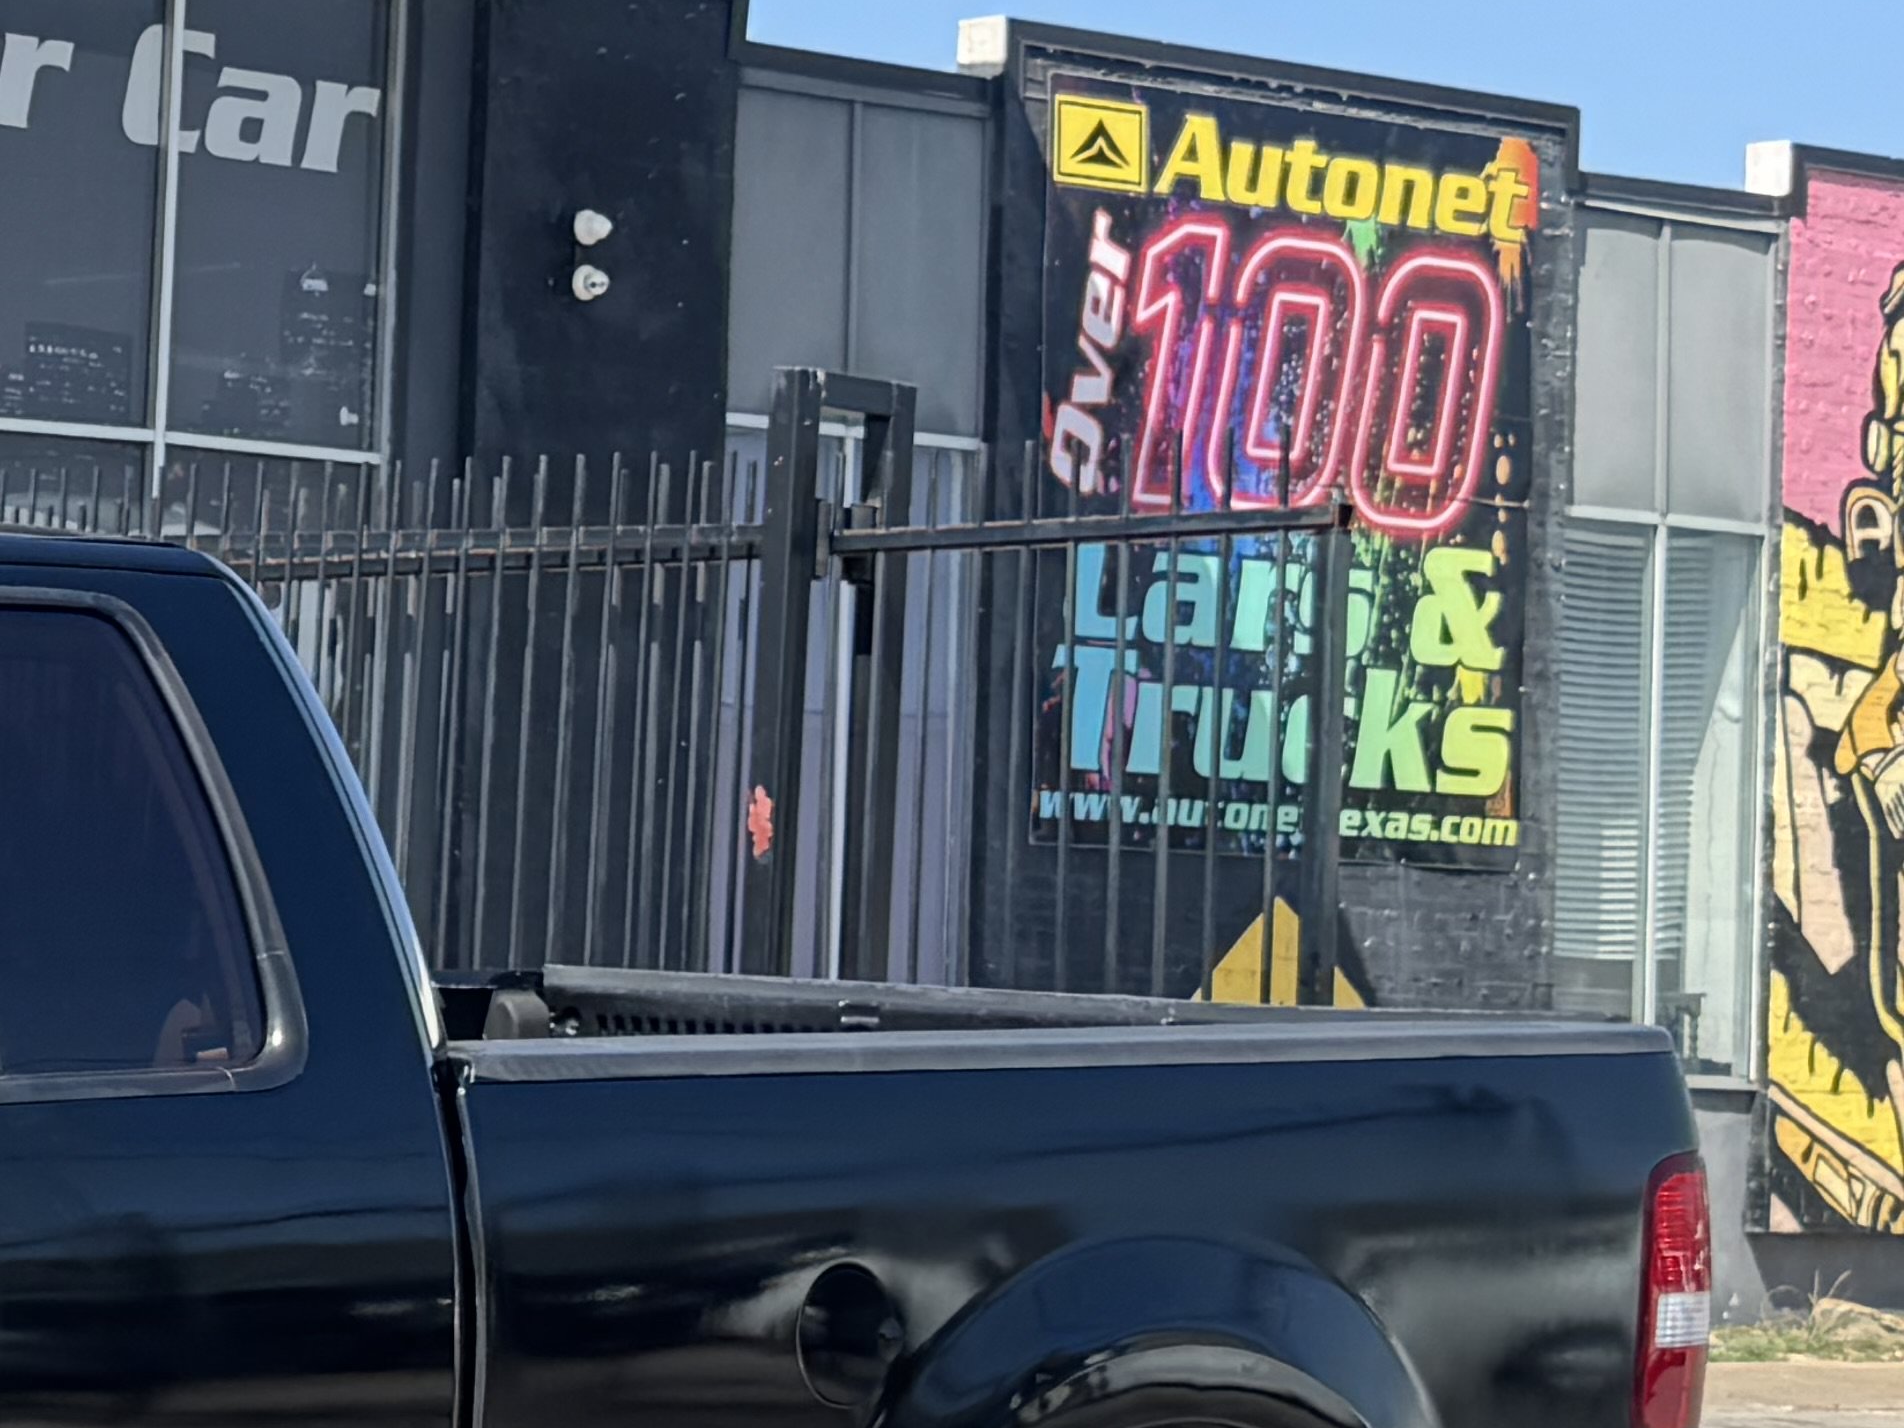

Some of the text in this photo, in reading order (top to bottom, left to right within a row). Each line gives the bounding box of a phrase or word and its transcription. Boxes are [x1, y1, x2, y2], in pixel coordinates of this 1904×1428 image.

[120, 22, 381, 174] Car
[1153, 114, 1529, 243] Autonet
[1049, 208, 1132, 495] Over
[1131, 213, 1503, 534] 100
[1410, 546, 1506, 671] &
[1051, 643, 1515, 797] Trucks
[1038, 789, 1519, 847] www.auoneexas.com
